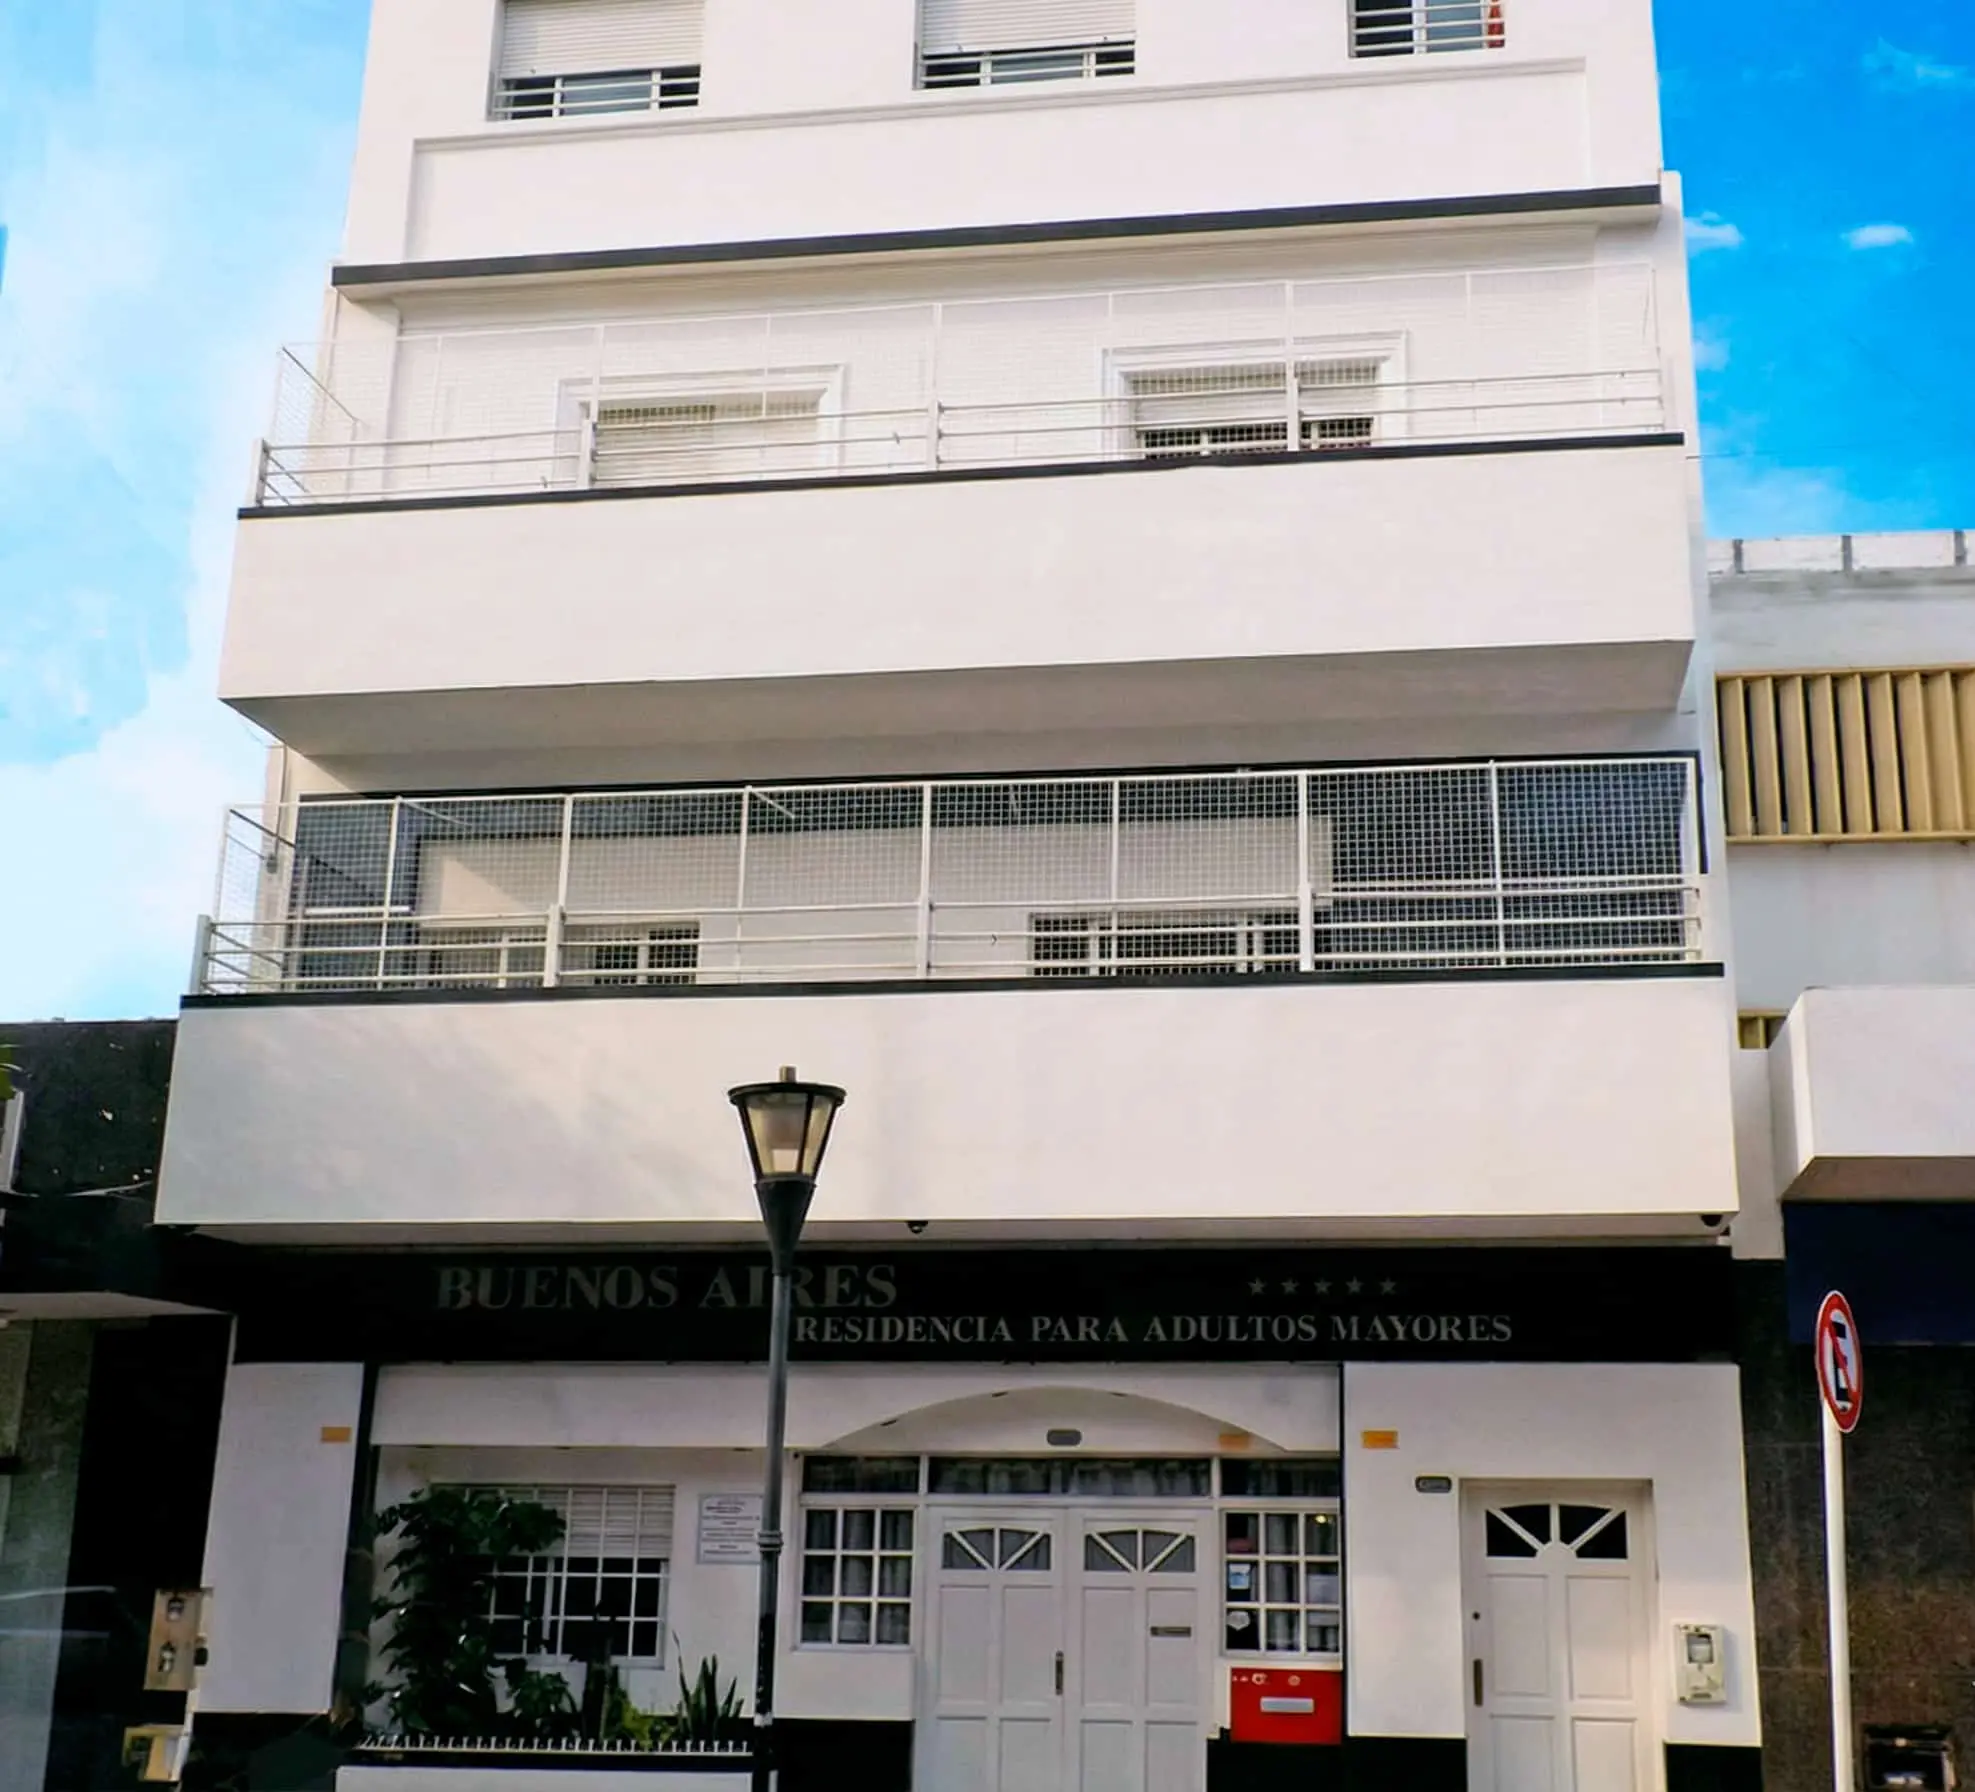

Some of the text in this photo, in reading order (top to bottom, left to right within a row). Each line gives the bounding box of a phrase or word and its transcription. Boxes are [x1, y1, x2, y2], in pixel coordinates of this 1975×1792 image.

[434, 1263, 680, 1311] BUENOS
[794, 1314, 1513, 1343] RESIDENCIA PARA ADULTOS MAYORES
